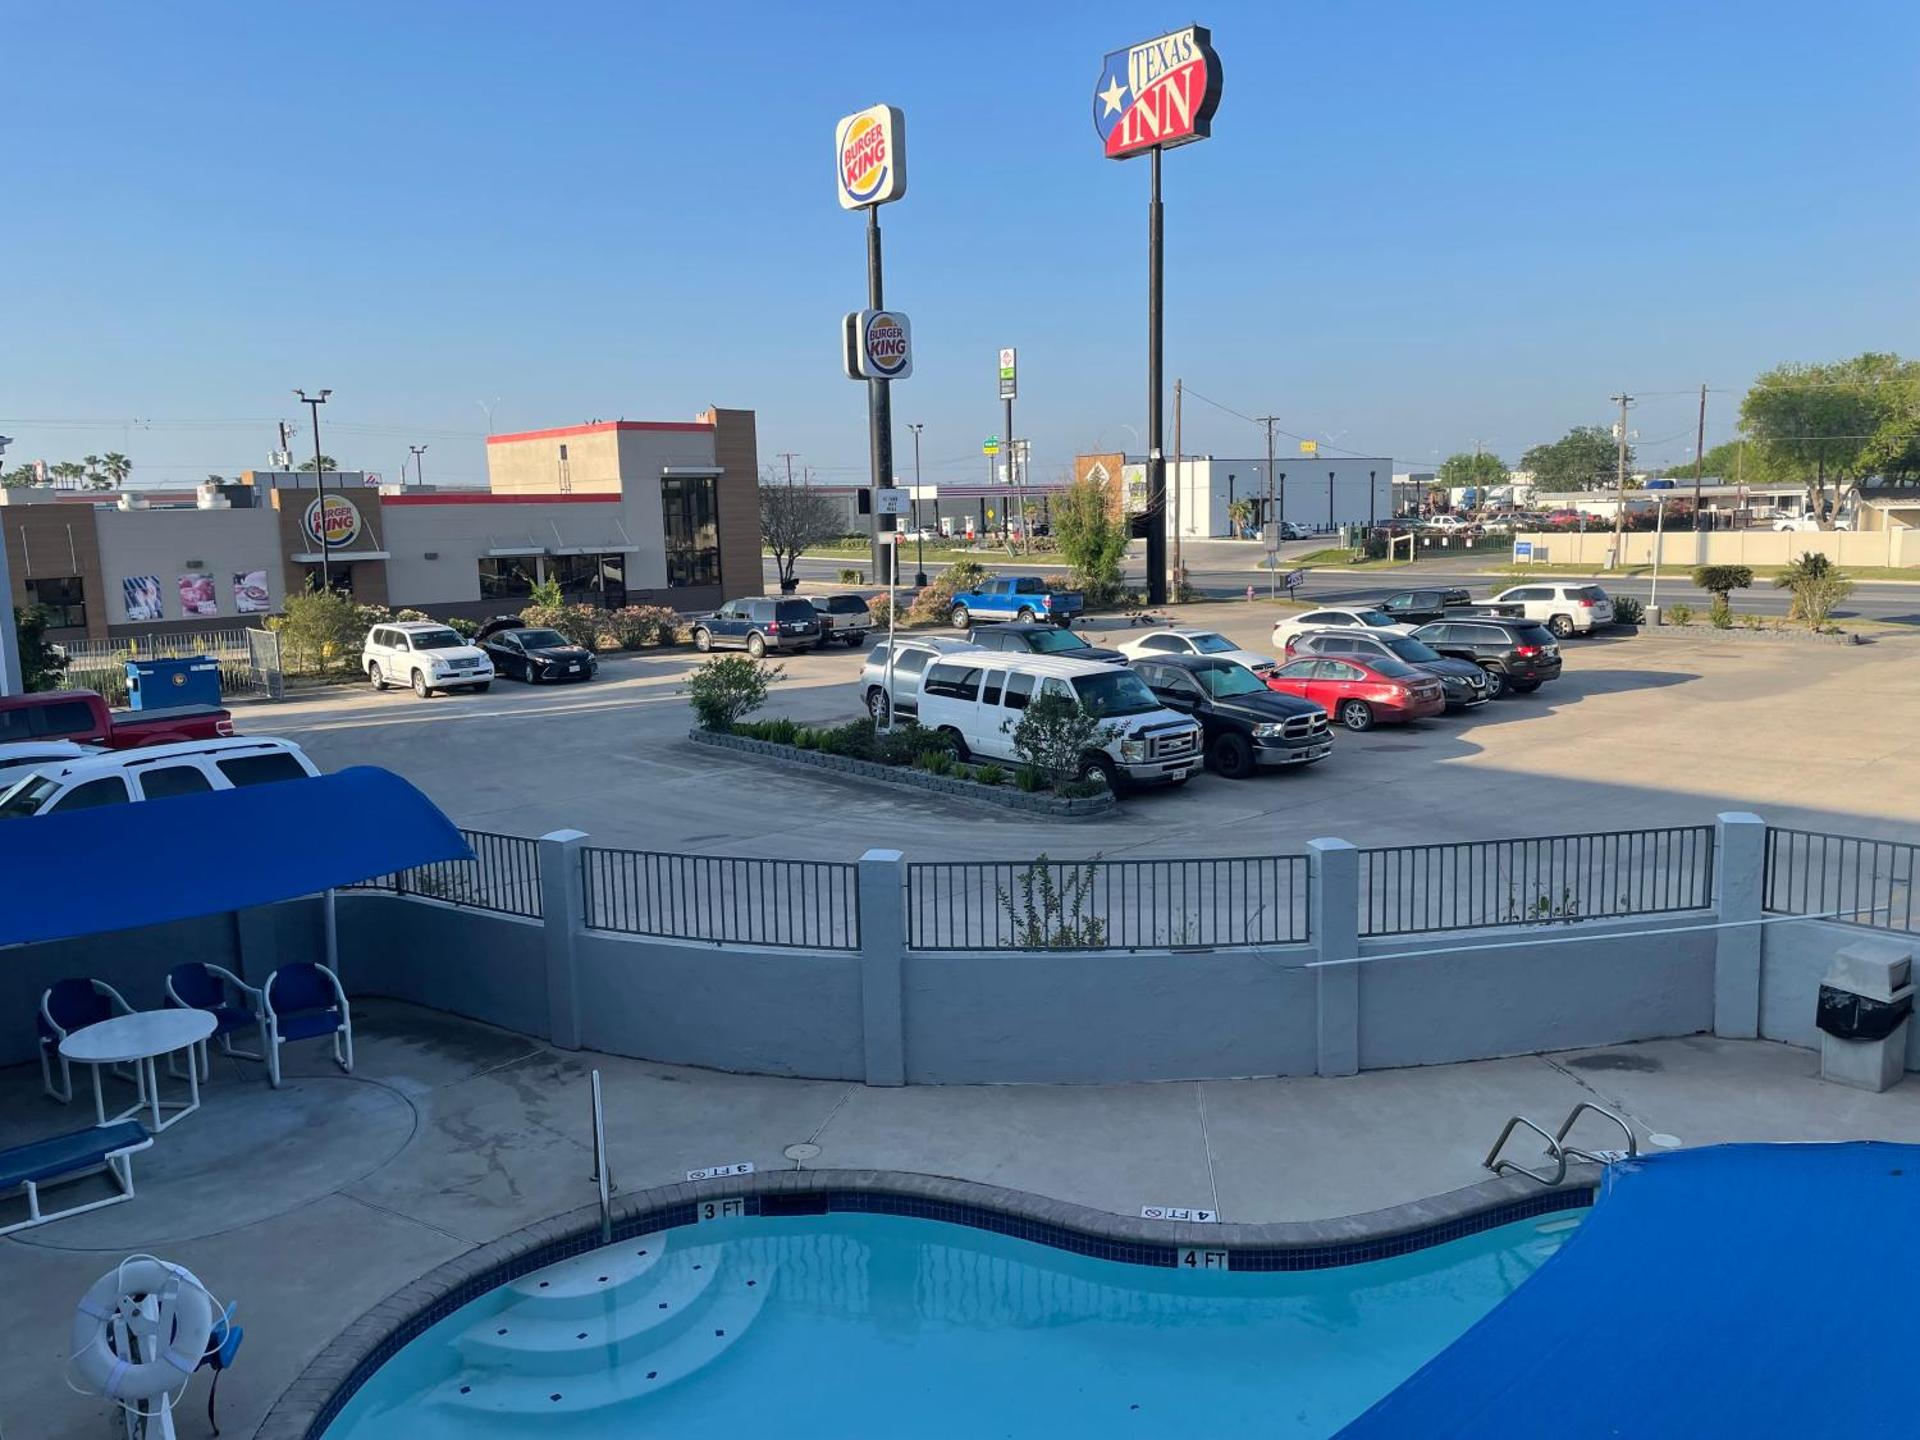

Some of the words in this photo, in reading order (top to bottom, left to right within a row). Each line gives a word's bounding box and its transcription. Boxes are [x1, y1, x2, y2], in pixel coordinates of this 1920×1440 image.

[1132, 31, 1192, 93] TEXAS
[1120, 65, 1194, 147] INN
[844, 123, 883, 167] BURGER
[846, 139, 885, 188] KING
[869, 327, 903, 340] BURGER
[870, 339, 906, 356] KING
[704, 1203, 716, 1220] 3
[722, 1200, 742, 1217] FT
[1168, 1209, 1190, 1220] FT
[1197, 1211, 1210, 1221] 4
[1184, 1250, 1198, 1268] 4
[1204, 1252, 1226, 1269] FT
